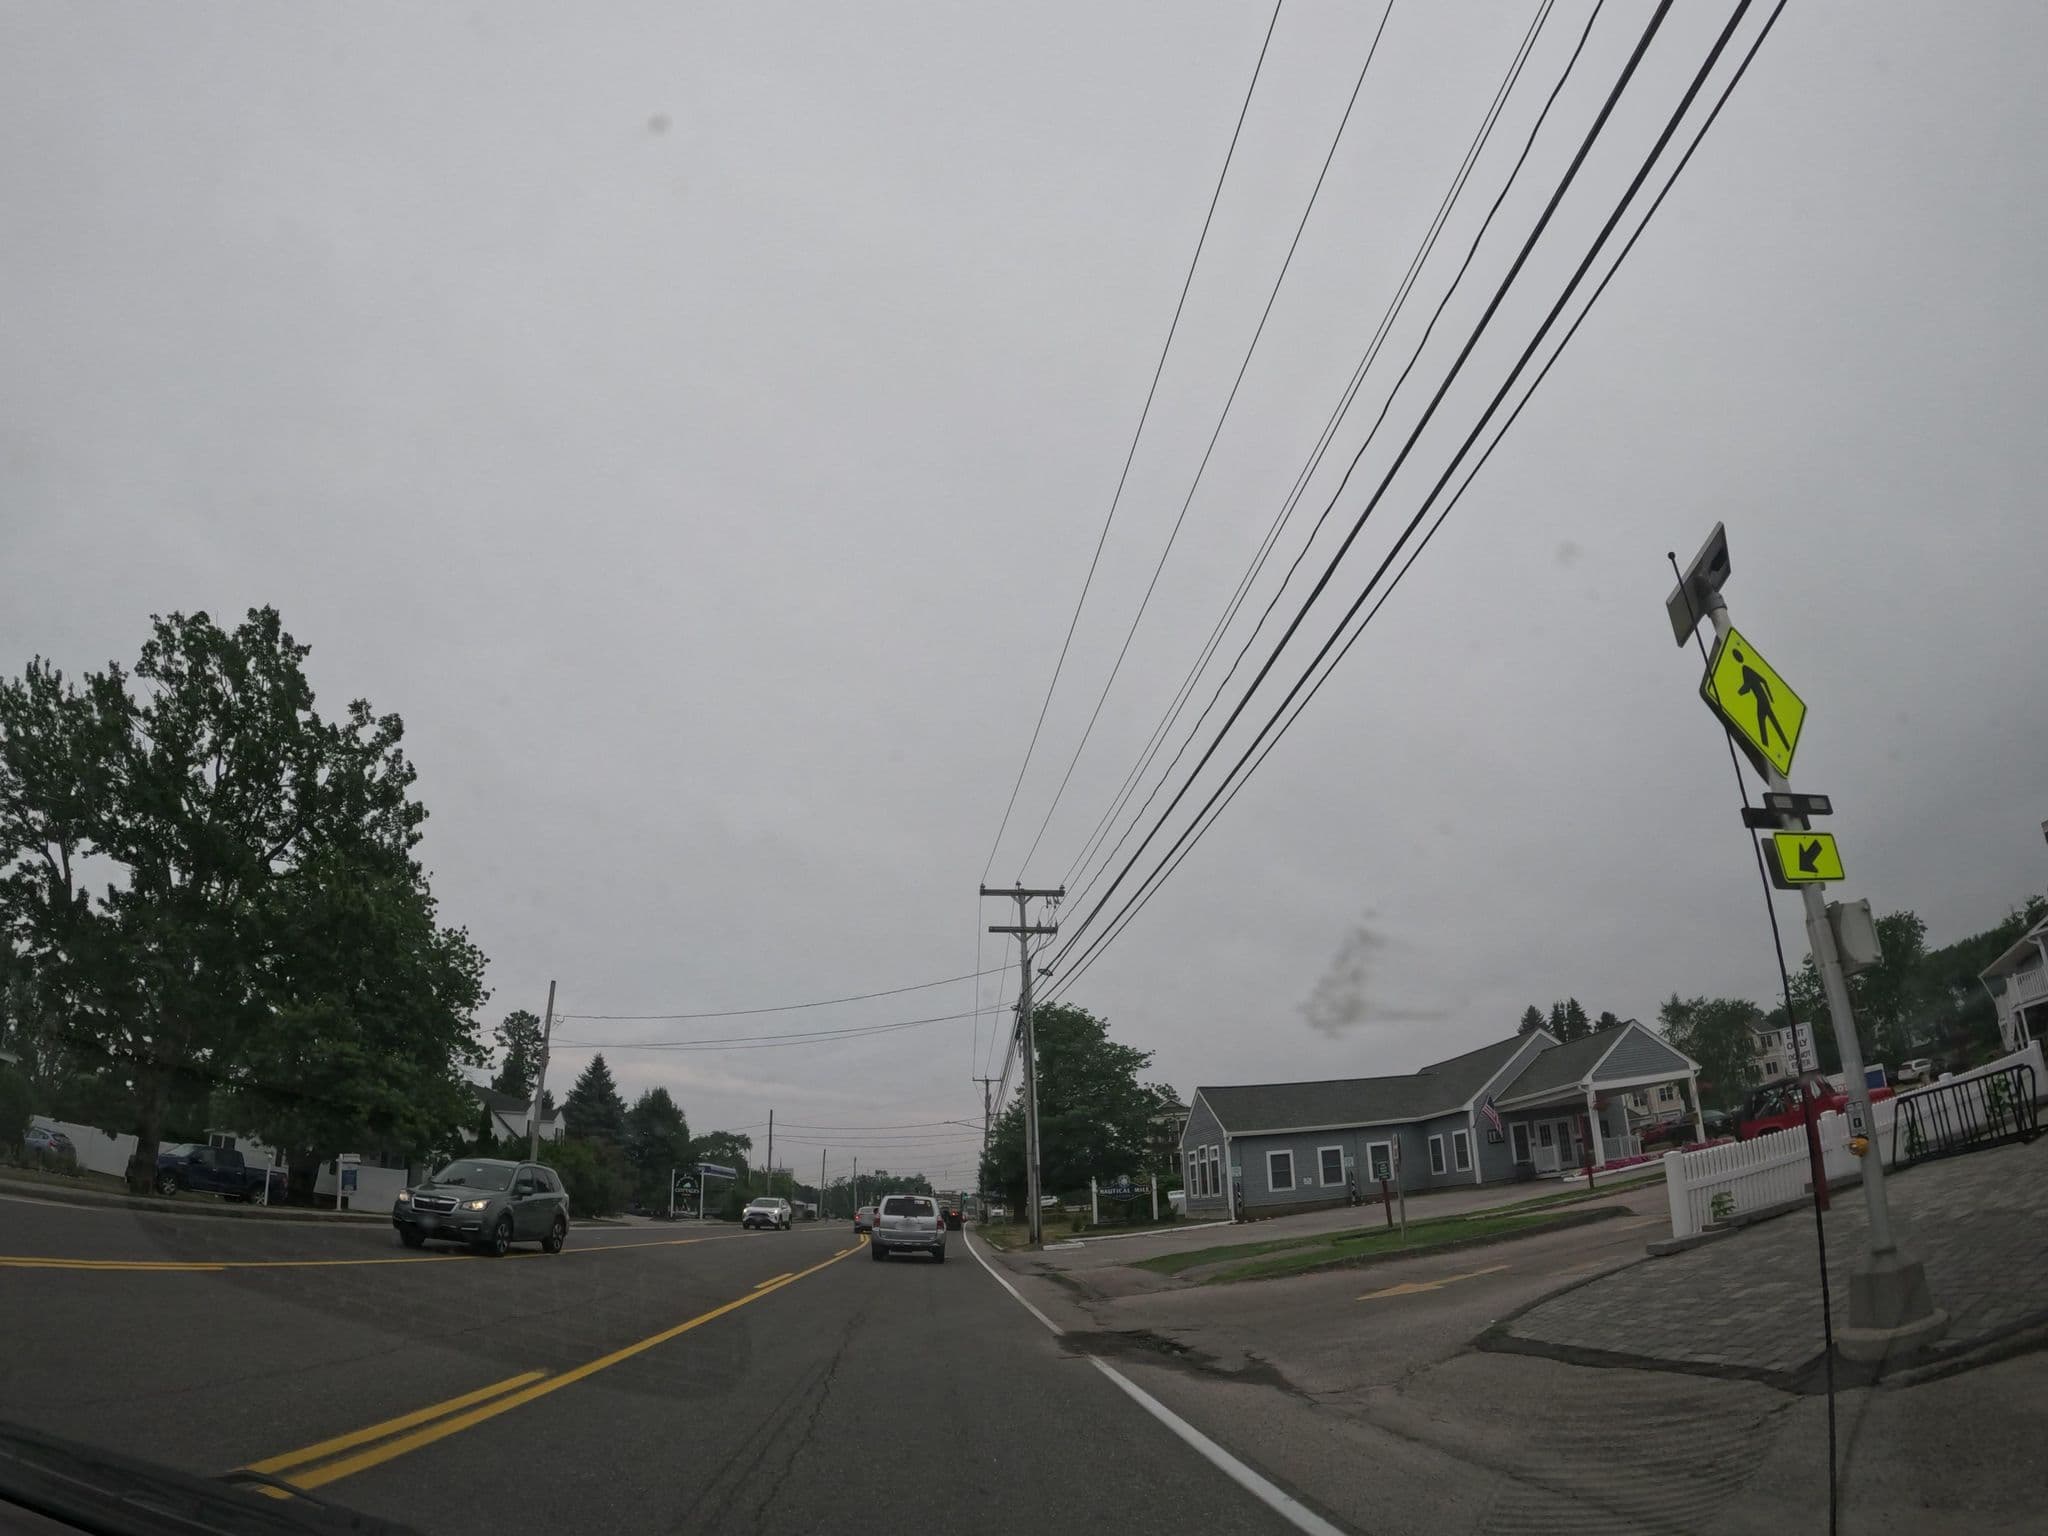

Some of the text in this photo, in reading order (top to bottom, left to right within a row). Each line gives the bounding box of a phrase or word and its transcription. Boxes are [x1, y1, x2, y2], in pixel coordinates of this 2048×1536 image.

[1786, 1028, 1804, 1040] EIT
[1787, 1038, 1808, 1050] OLY
[1099, 1187, 1130, 1195] NAUTICAL
